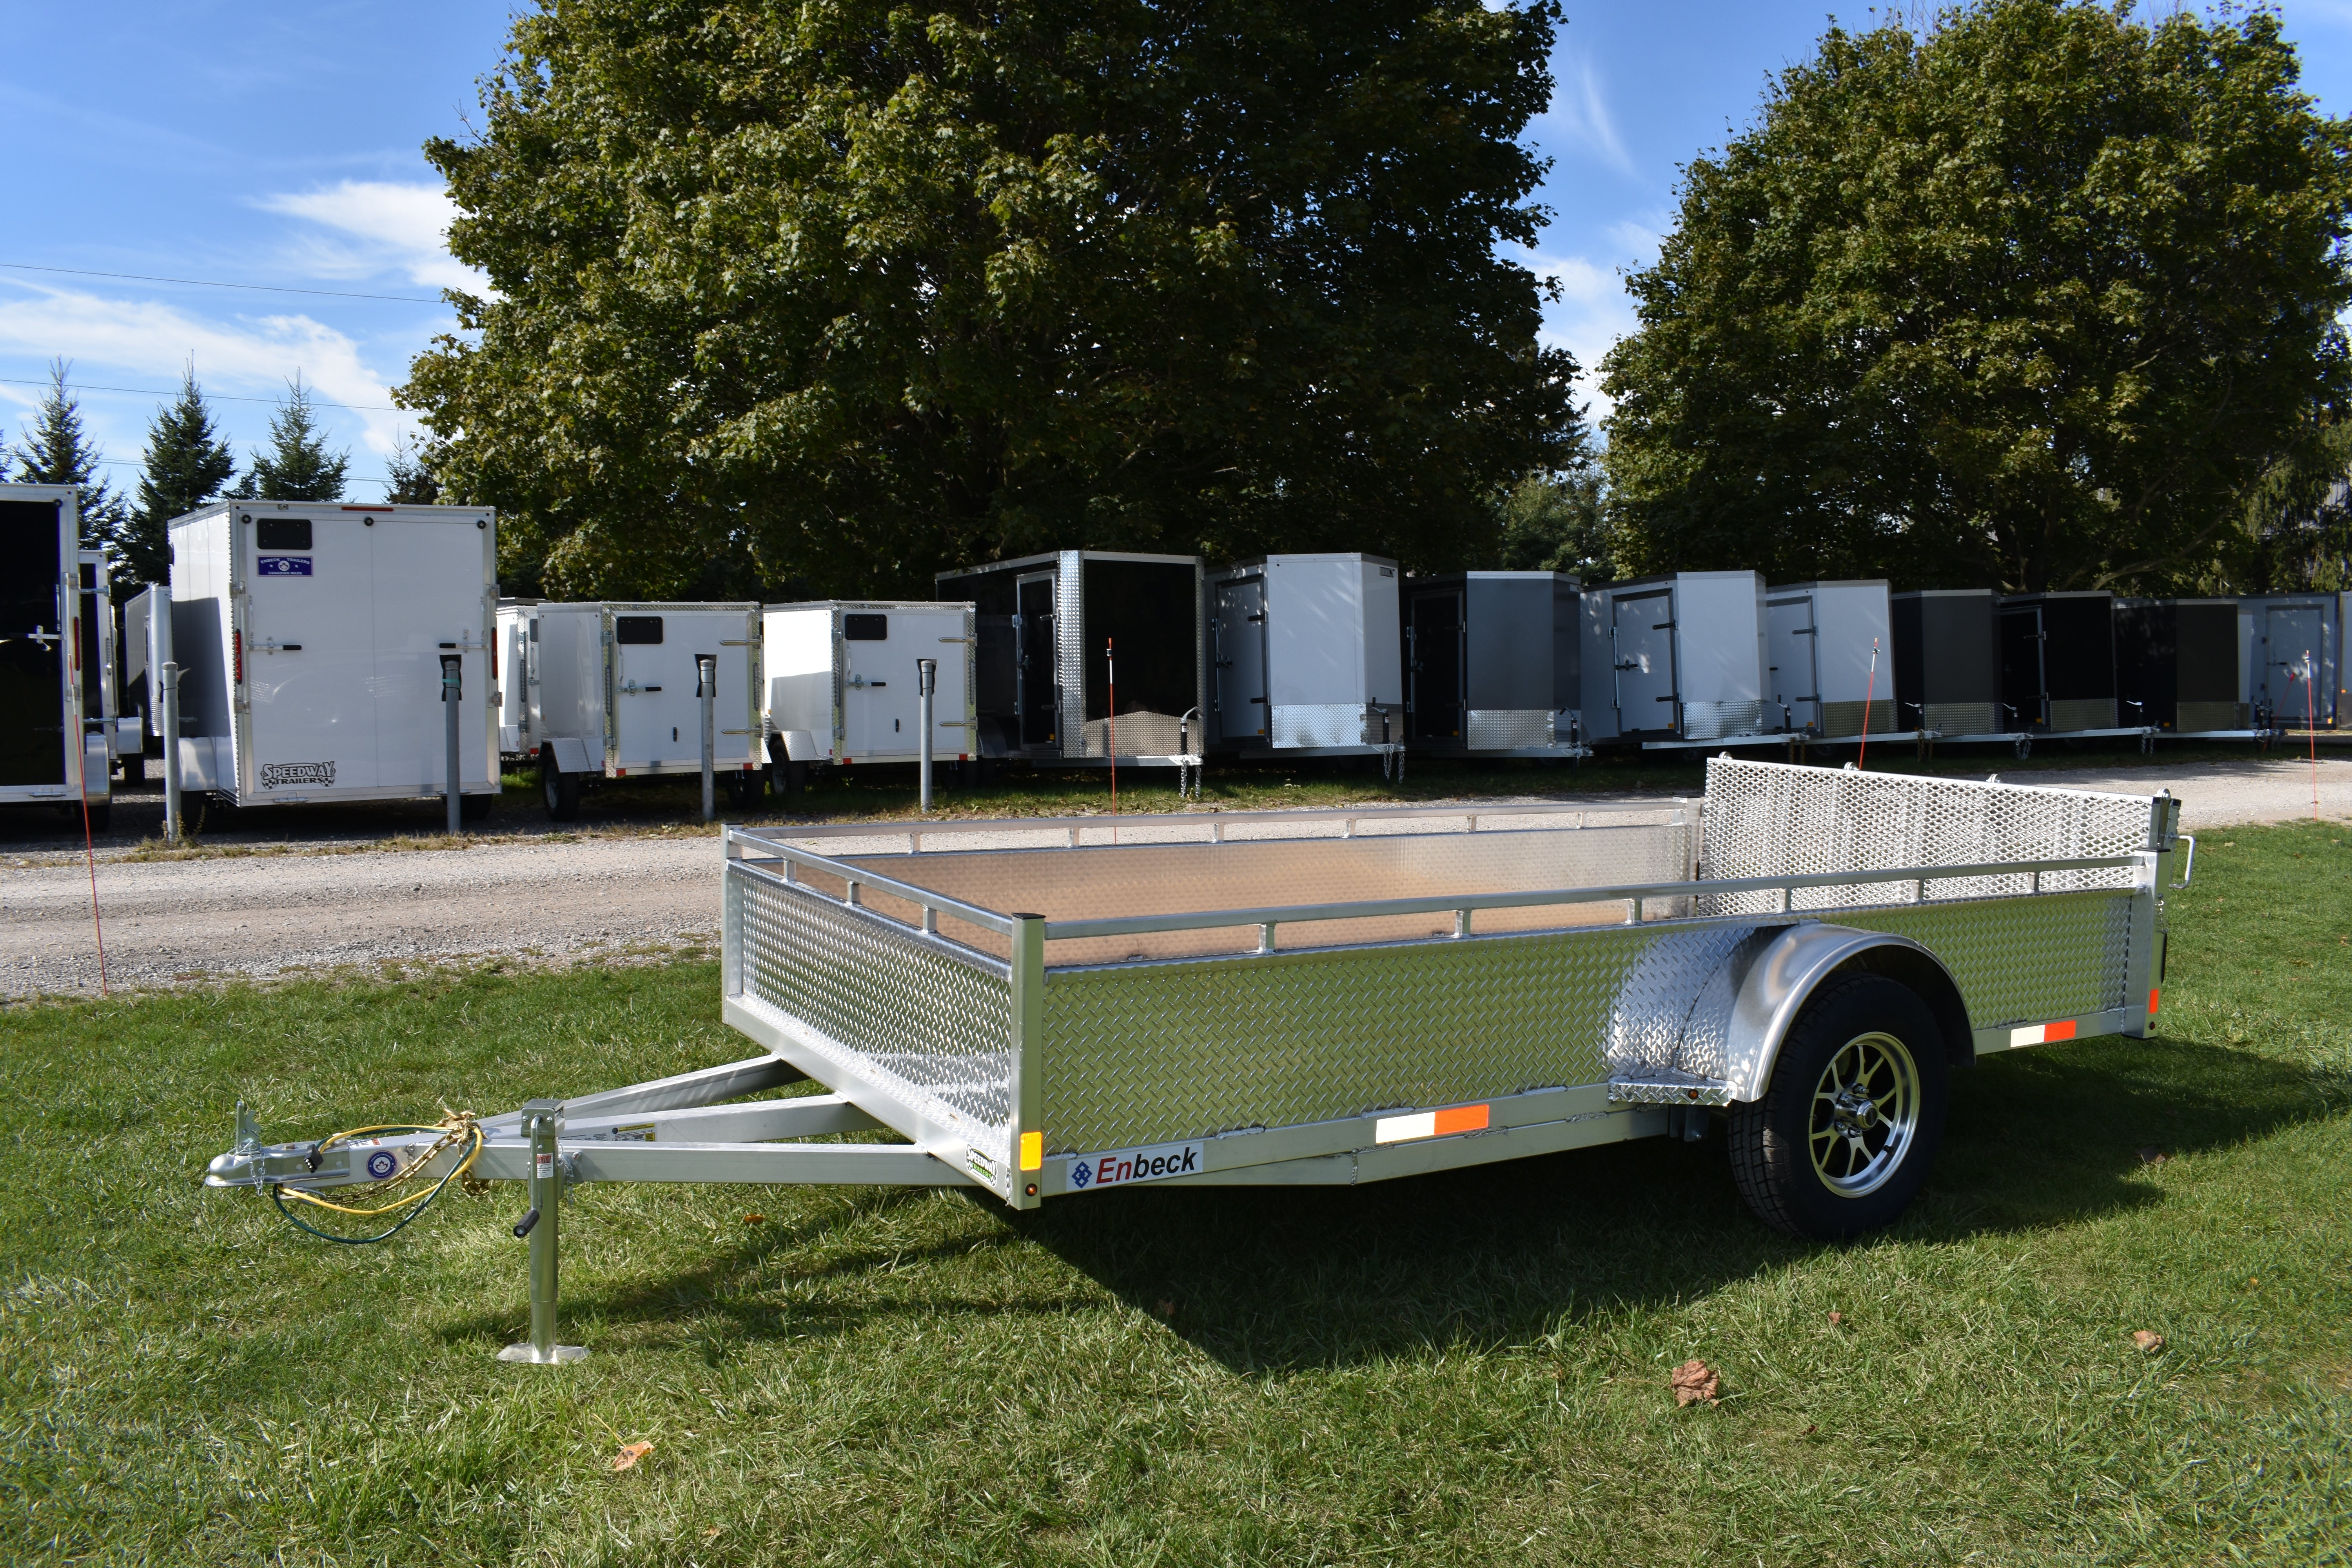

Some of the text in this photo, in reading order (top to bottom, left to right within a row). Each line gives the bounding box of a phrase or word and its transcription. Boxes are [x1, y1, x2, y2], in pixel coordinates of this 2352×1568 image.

[262, 761, 335, 780] SPEEDWAY
[967, 1144, 996, 1176] SPEEDWAY
[972, 1162, 991, 1179] TRAILERS
[1096, 1147, 1198, 1184] Enbeck
